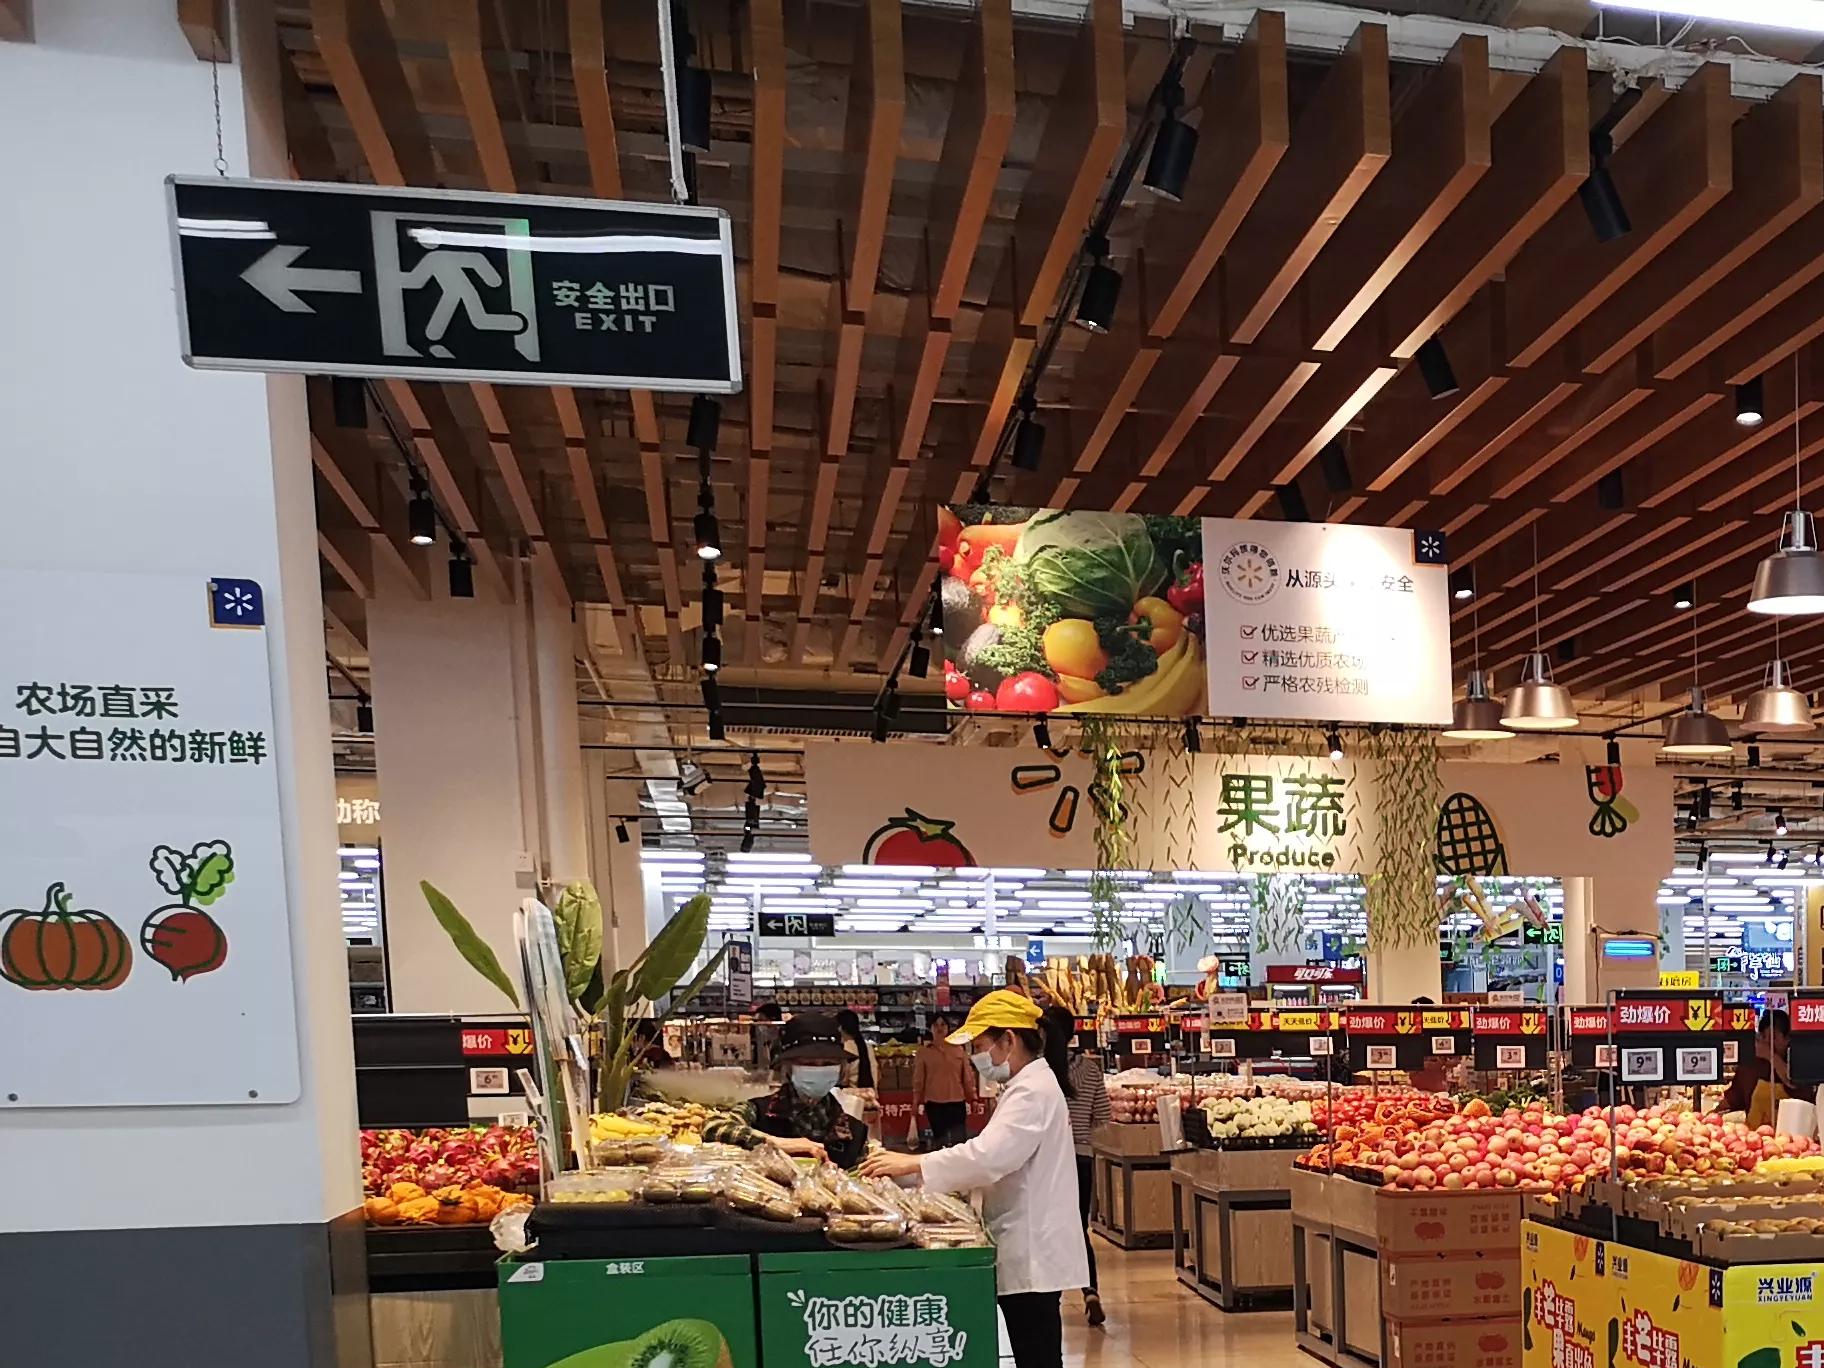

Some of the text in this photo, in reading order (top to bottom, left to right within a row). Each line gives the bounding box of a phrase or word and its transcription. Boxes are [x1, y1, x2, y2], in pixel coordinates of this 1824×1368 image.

[552, 281, 675, 313] 安全出口
[575, 314, 657, 333] EXIT
[1263, 675, 1369, 696] 严格农残检测
[16, 683, 178, 720] 农场直采
[1217, 773, 1347, 838] 果蔬
[1230, 844, 1335, 868] Produce
[1476, 1016, 1511, 1029] 劲爆价
[1574, 1016, 1607, 1029] 劲爆价
[1620, 1005, 1671, 1024] 劲爆价
[606, 1262, 645, 1275] 盒装区
[1757, 1276, 1813, 1294] 兴业源
[805, 1295, 947, 1330] 你的健康
